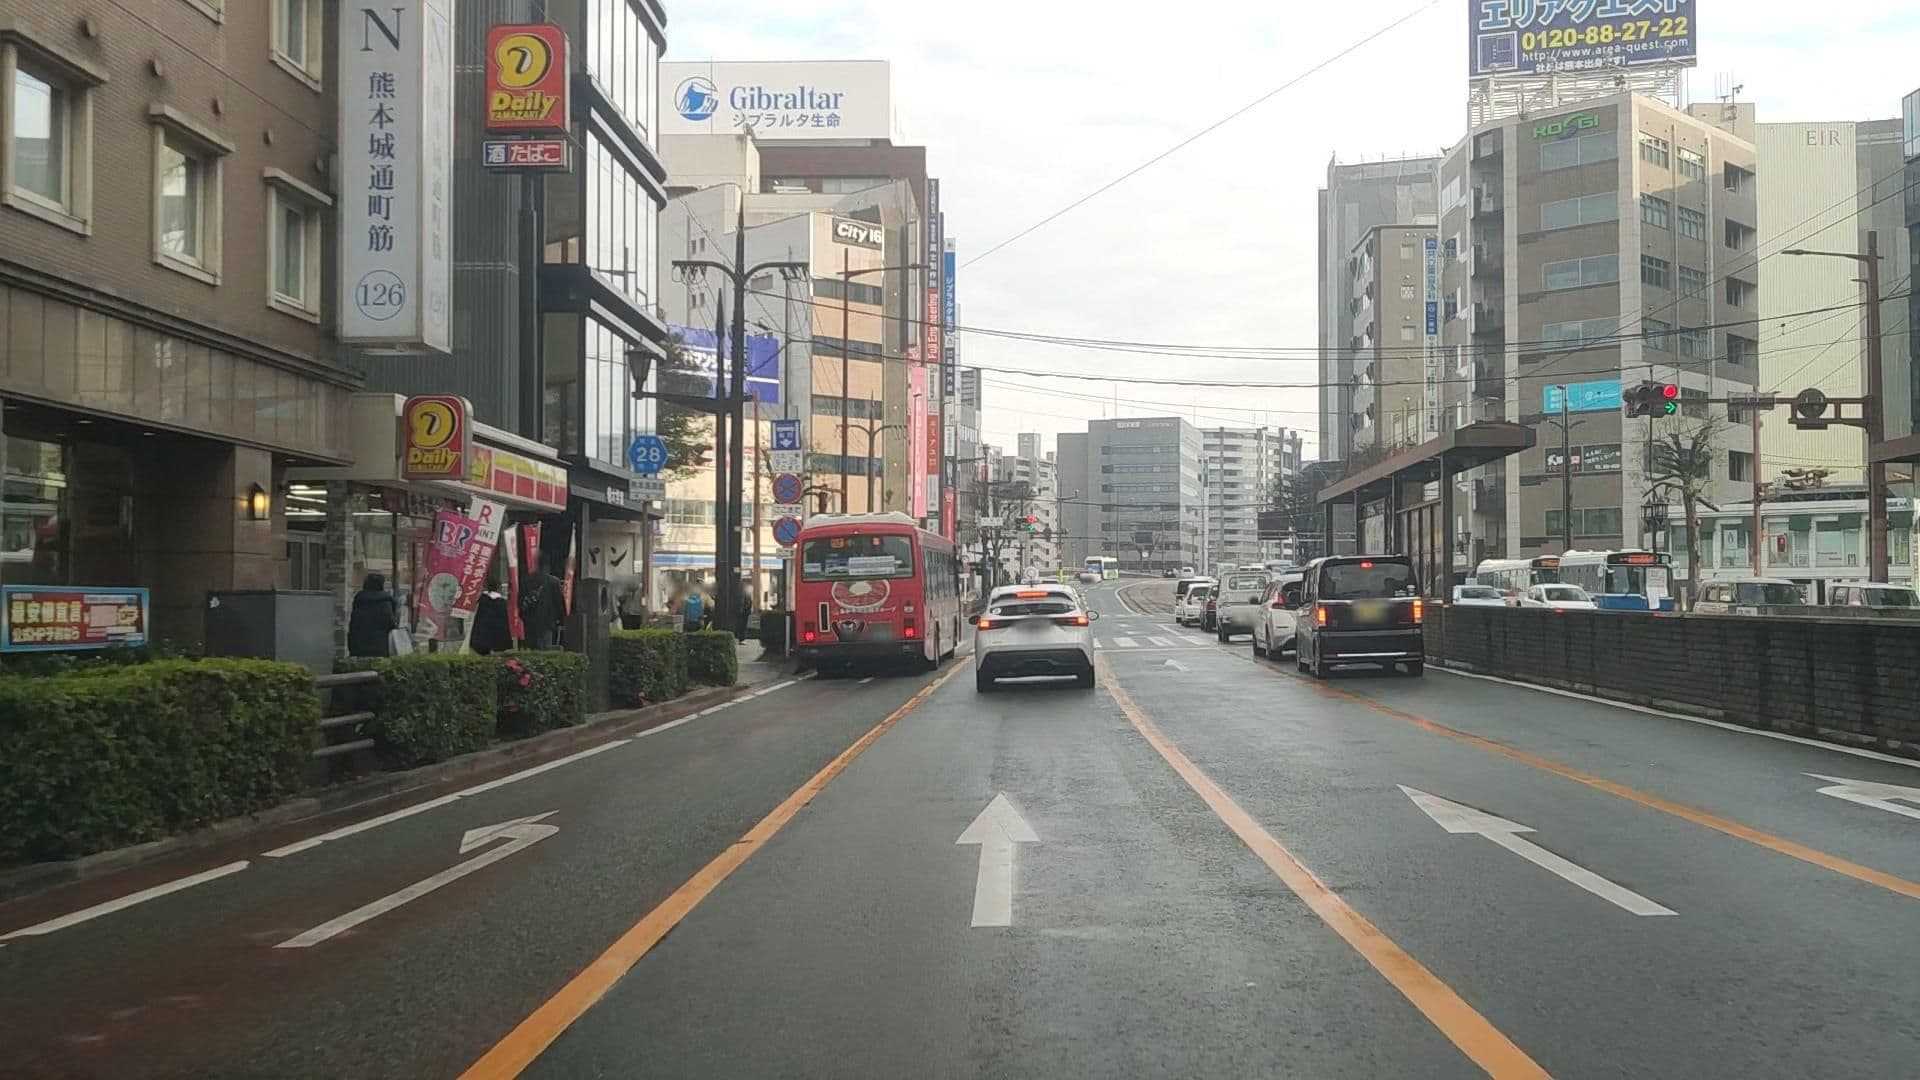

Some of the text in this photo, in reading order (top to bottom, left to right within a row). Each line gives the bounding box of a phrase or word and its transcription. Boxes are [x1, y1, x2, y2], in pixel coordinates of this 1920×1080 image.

[360, 8, 405, 51] N
[1521, 17, 1689, 50] 0120-88-27-22
[491, 91, 560, 119] Daily
[730, 86, 844, 110] Gibraltar
[732, 113, 841, 129] ジブラルタ生命
[1807, 130, 1841, 146] EIR
[368, 72, 395, 252] 熊本城通町筋
[487, 144, 560, 163] 酒 たばこ
[837, 222, 883, 244] City 16
[359, 283, 403, 307] 126
[408, 449, 458, 472] Daily
[637, 447, 661, 463] 28
